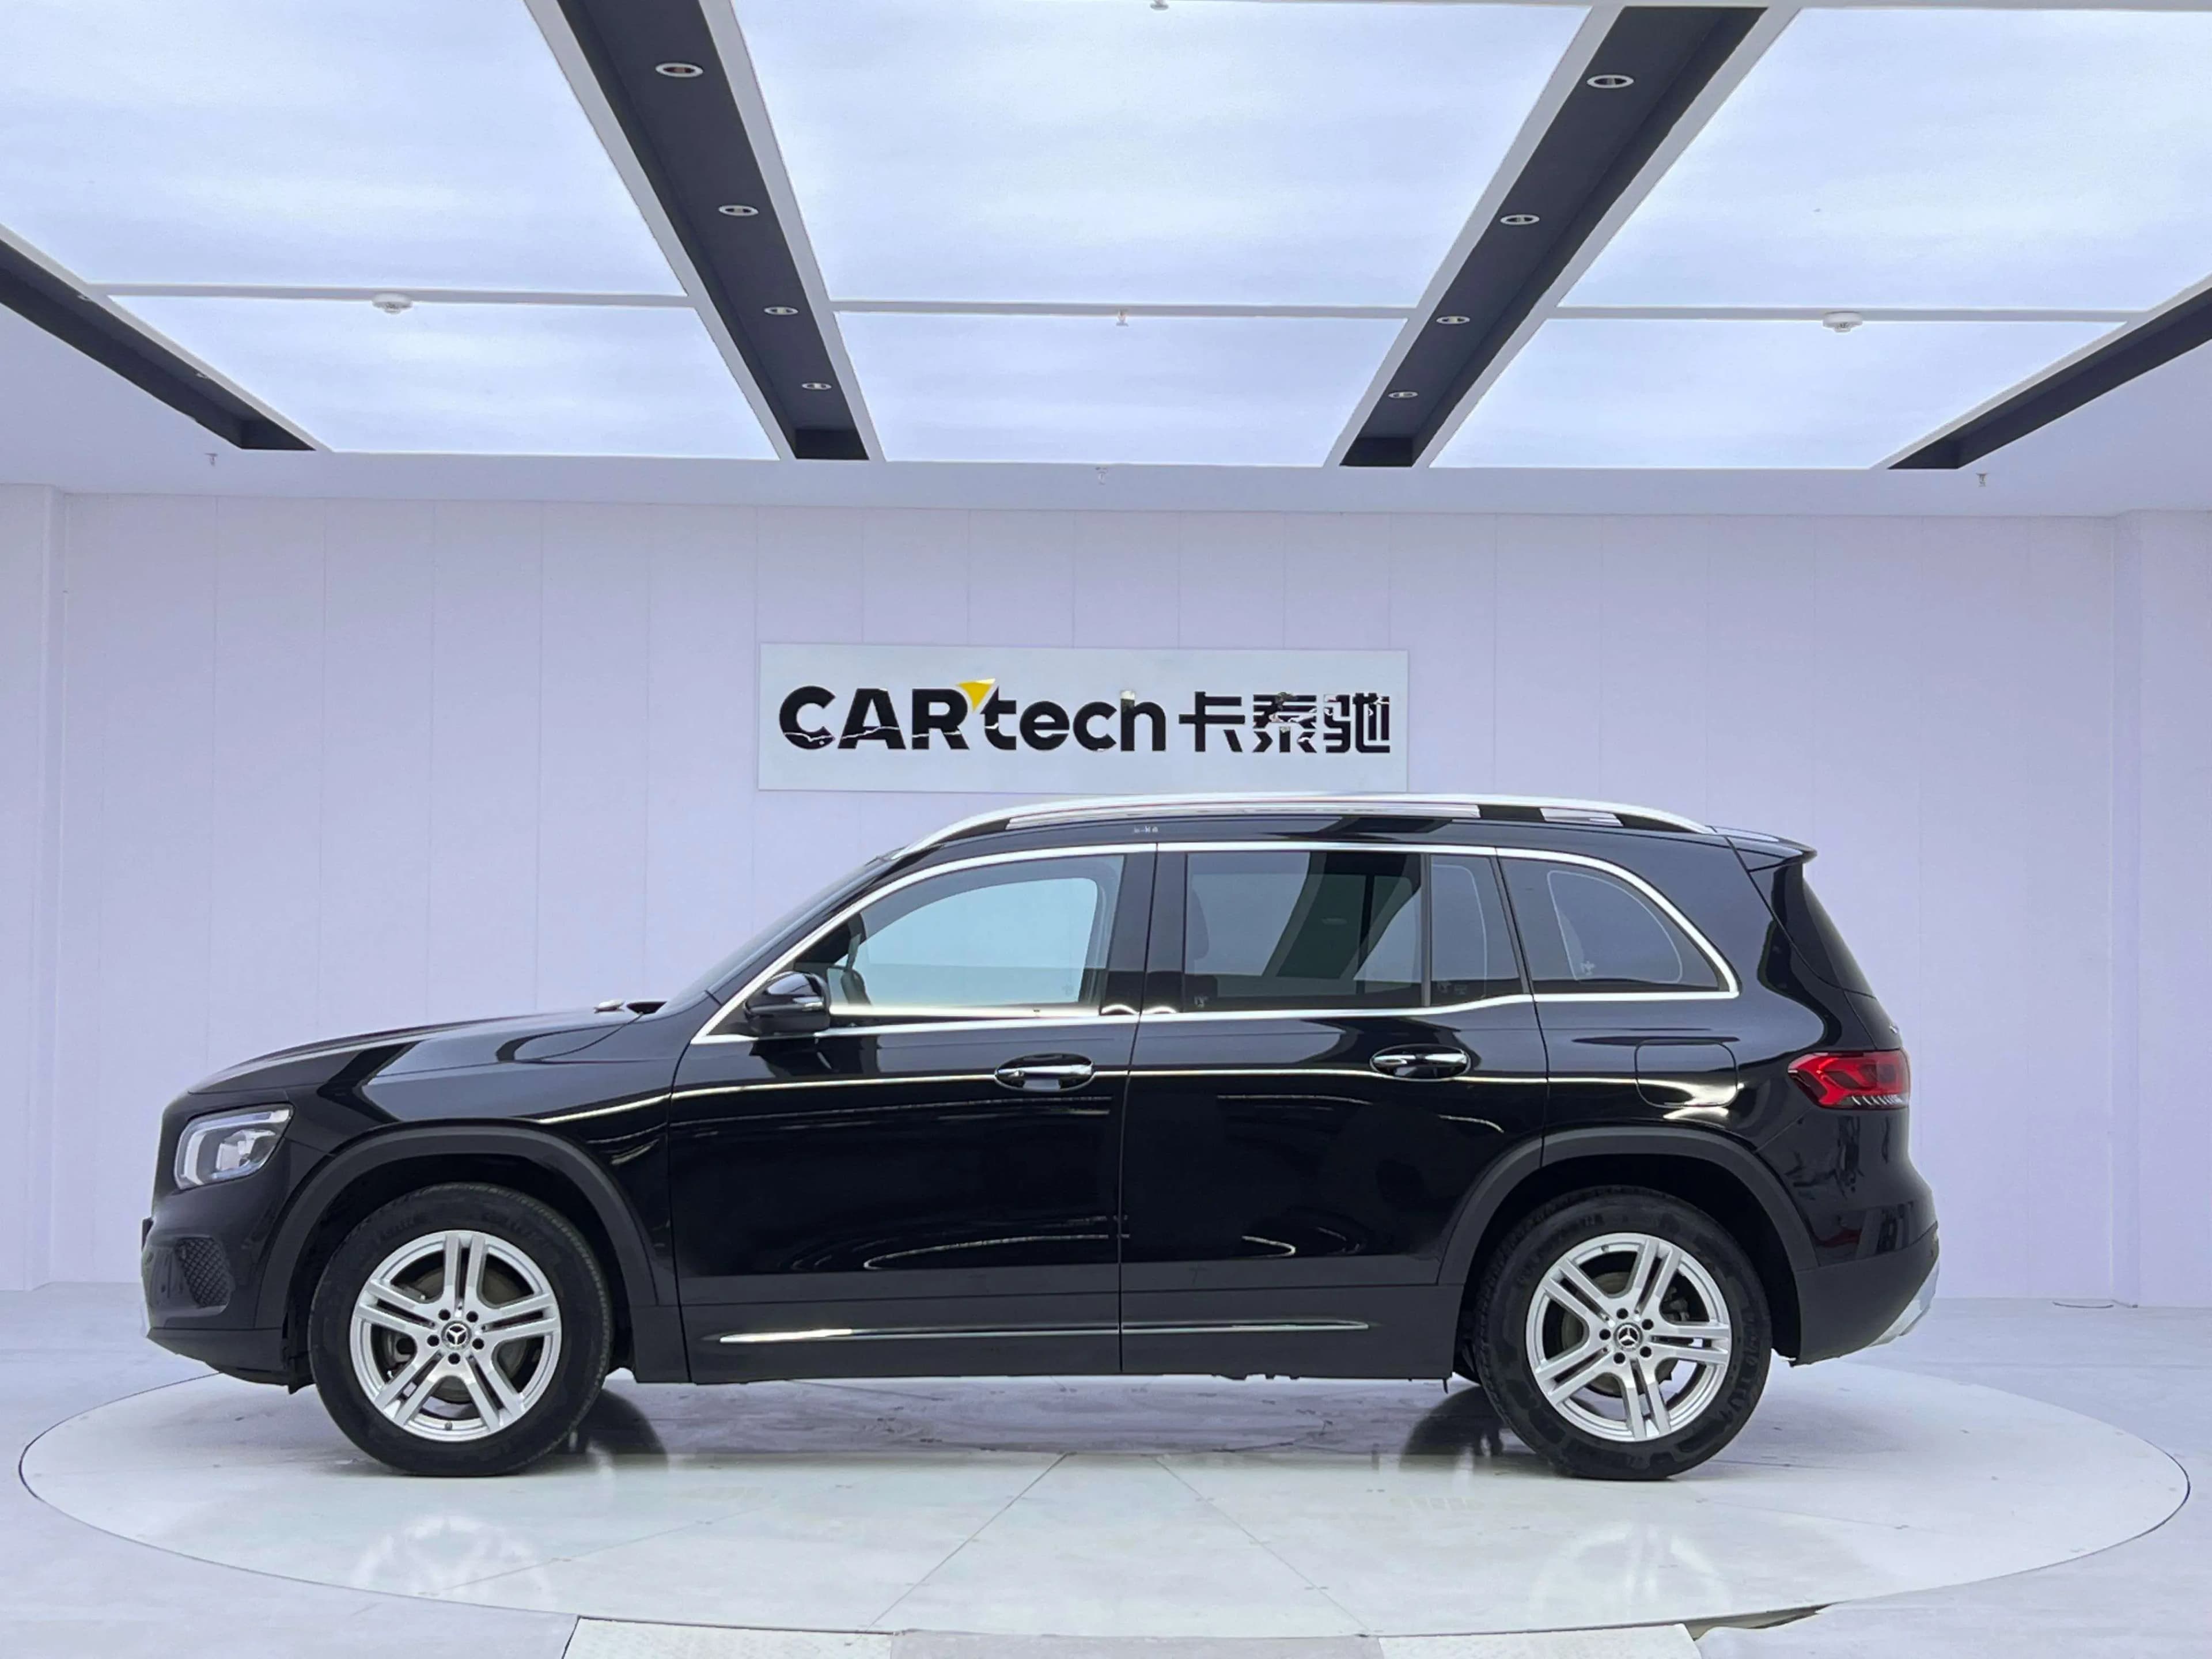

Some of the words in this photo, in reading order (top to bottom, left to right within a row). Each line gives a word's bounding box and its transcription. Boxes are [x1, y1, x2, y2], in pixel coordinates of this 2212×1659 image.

[779, 680, 1166, 752] CARtech
[1178, 691, 1391, 753] 卡泰驰
